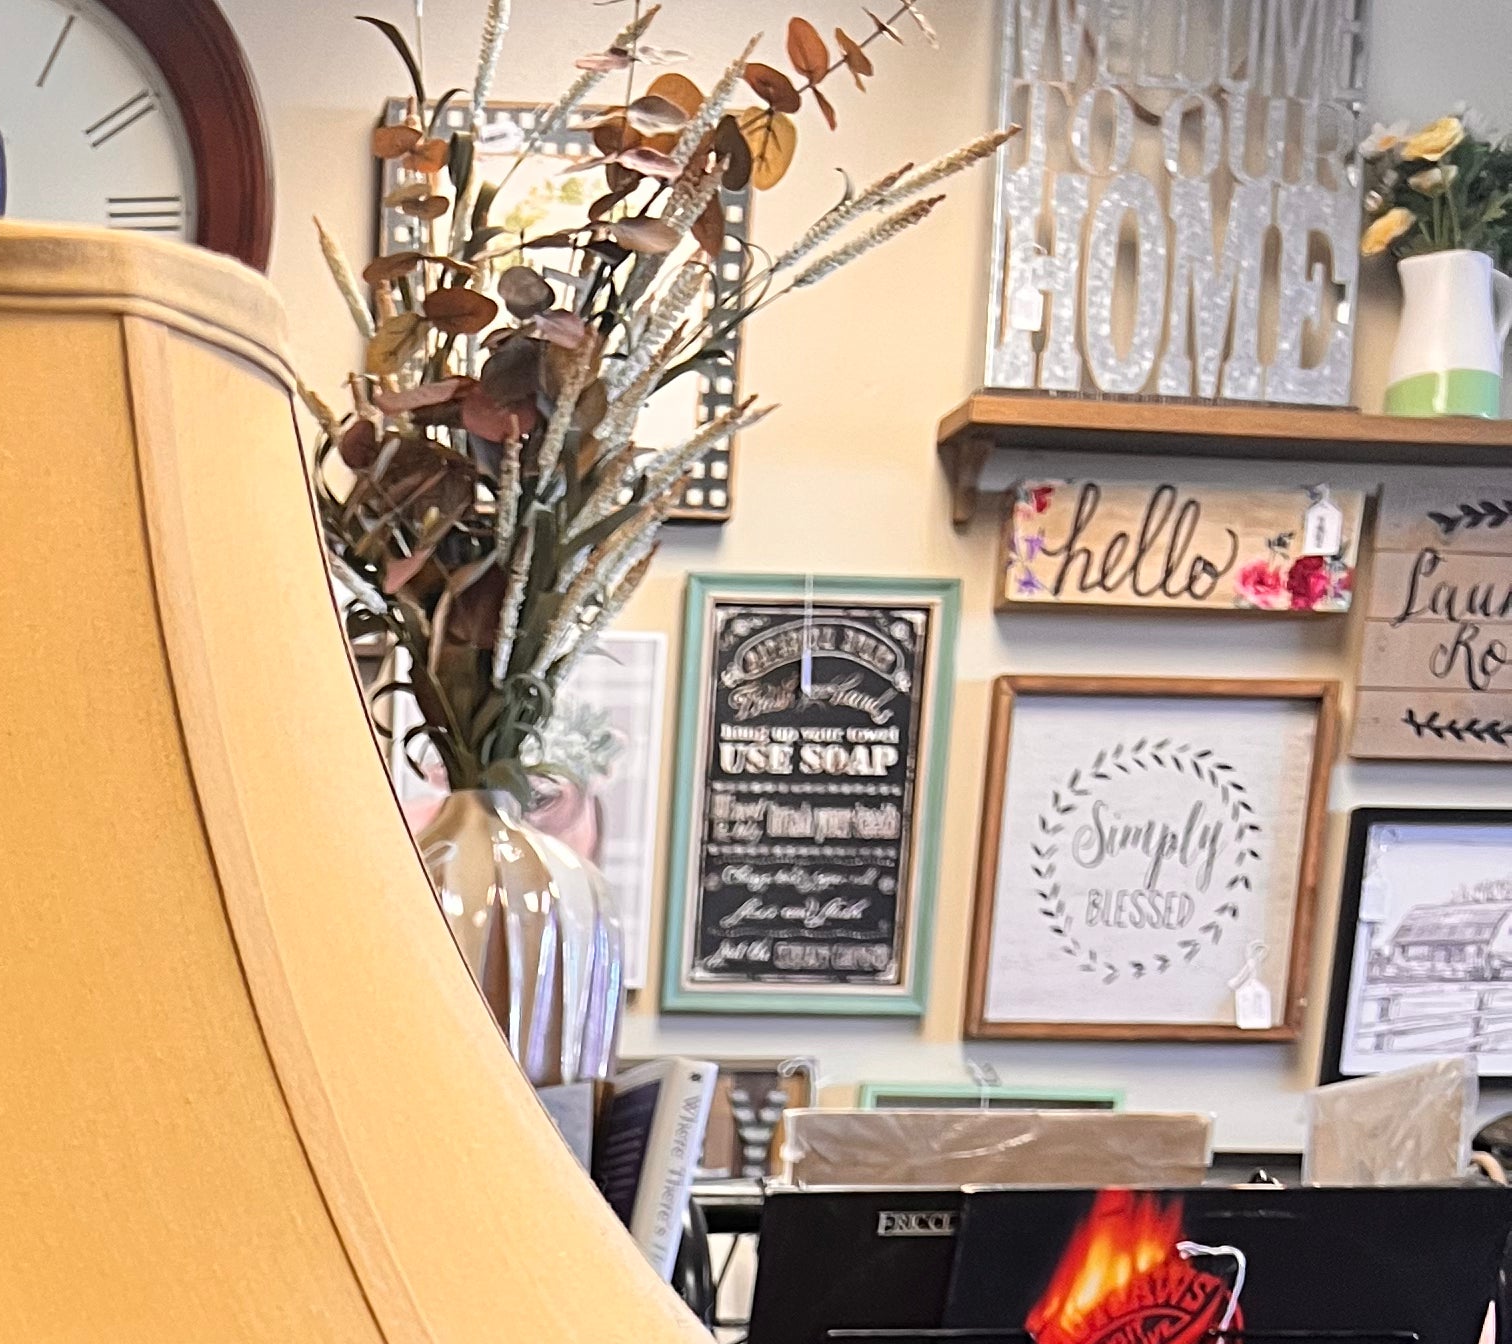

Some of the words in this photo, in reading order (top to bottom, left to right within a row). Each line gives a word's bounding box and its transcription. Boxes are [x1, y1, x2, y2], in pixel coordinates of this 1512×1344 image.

[985, 168, 1360, 405] HOME
[1041, 482, 1238, 600] hello
[719, 742, 794, 774] USE
[799, 744, 899, 776] SOAP
[1072, 799, 1224, 893] Simply
[1084, 888, 1196, 929] BLESSED
